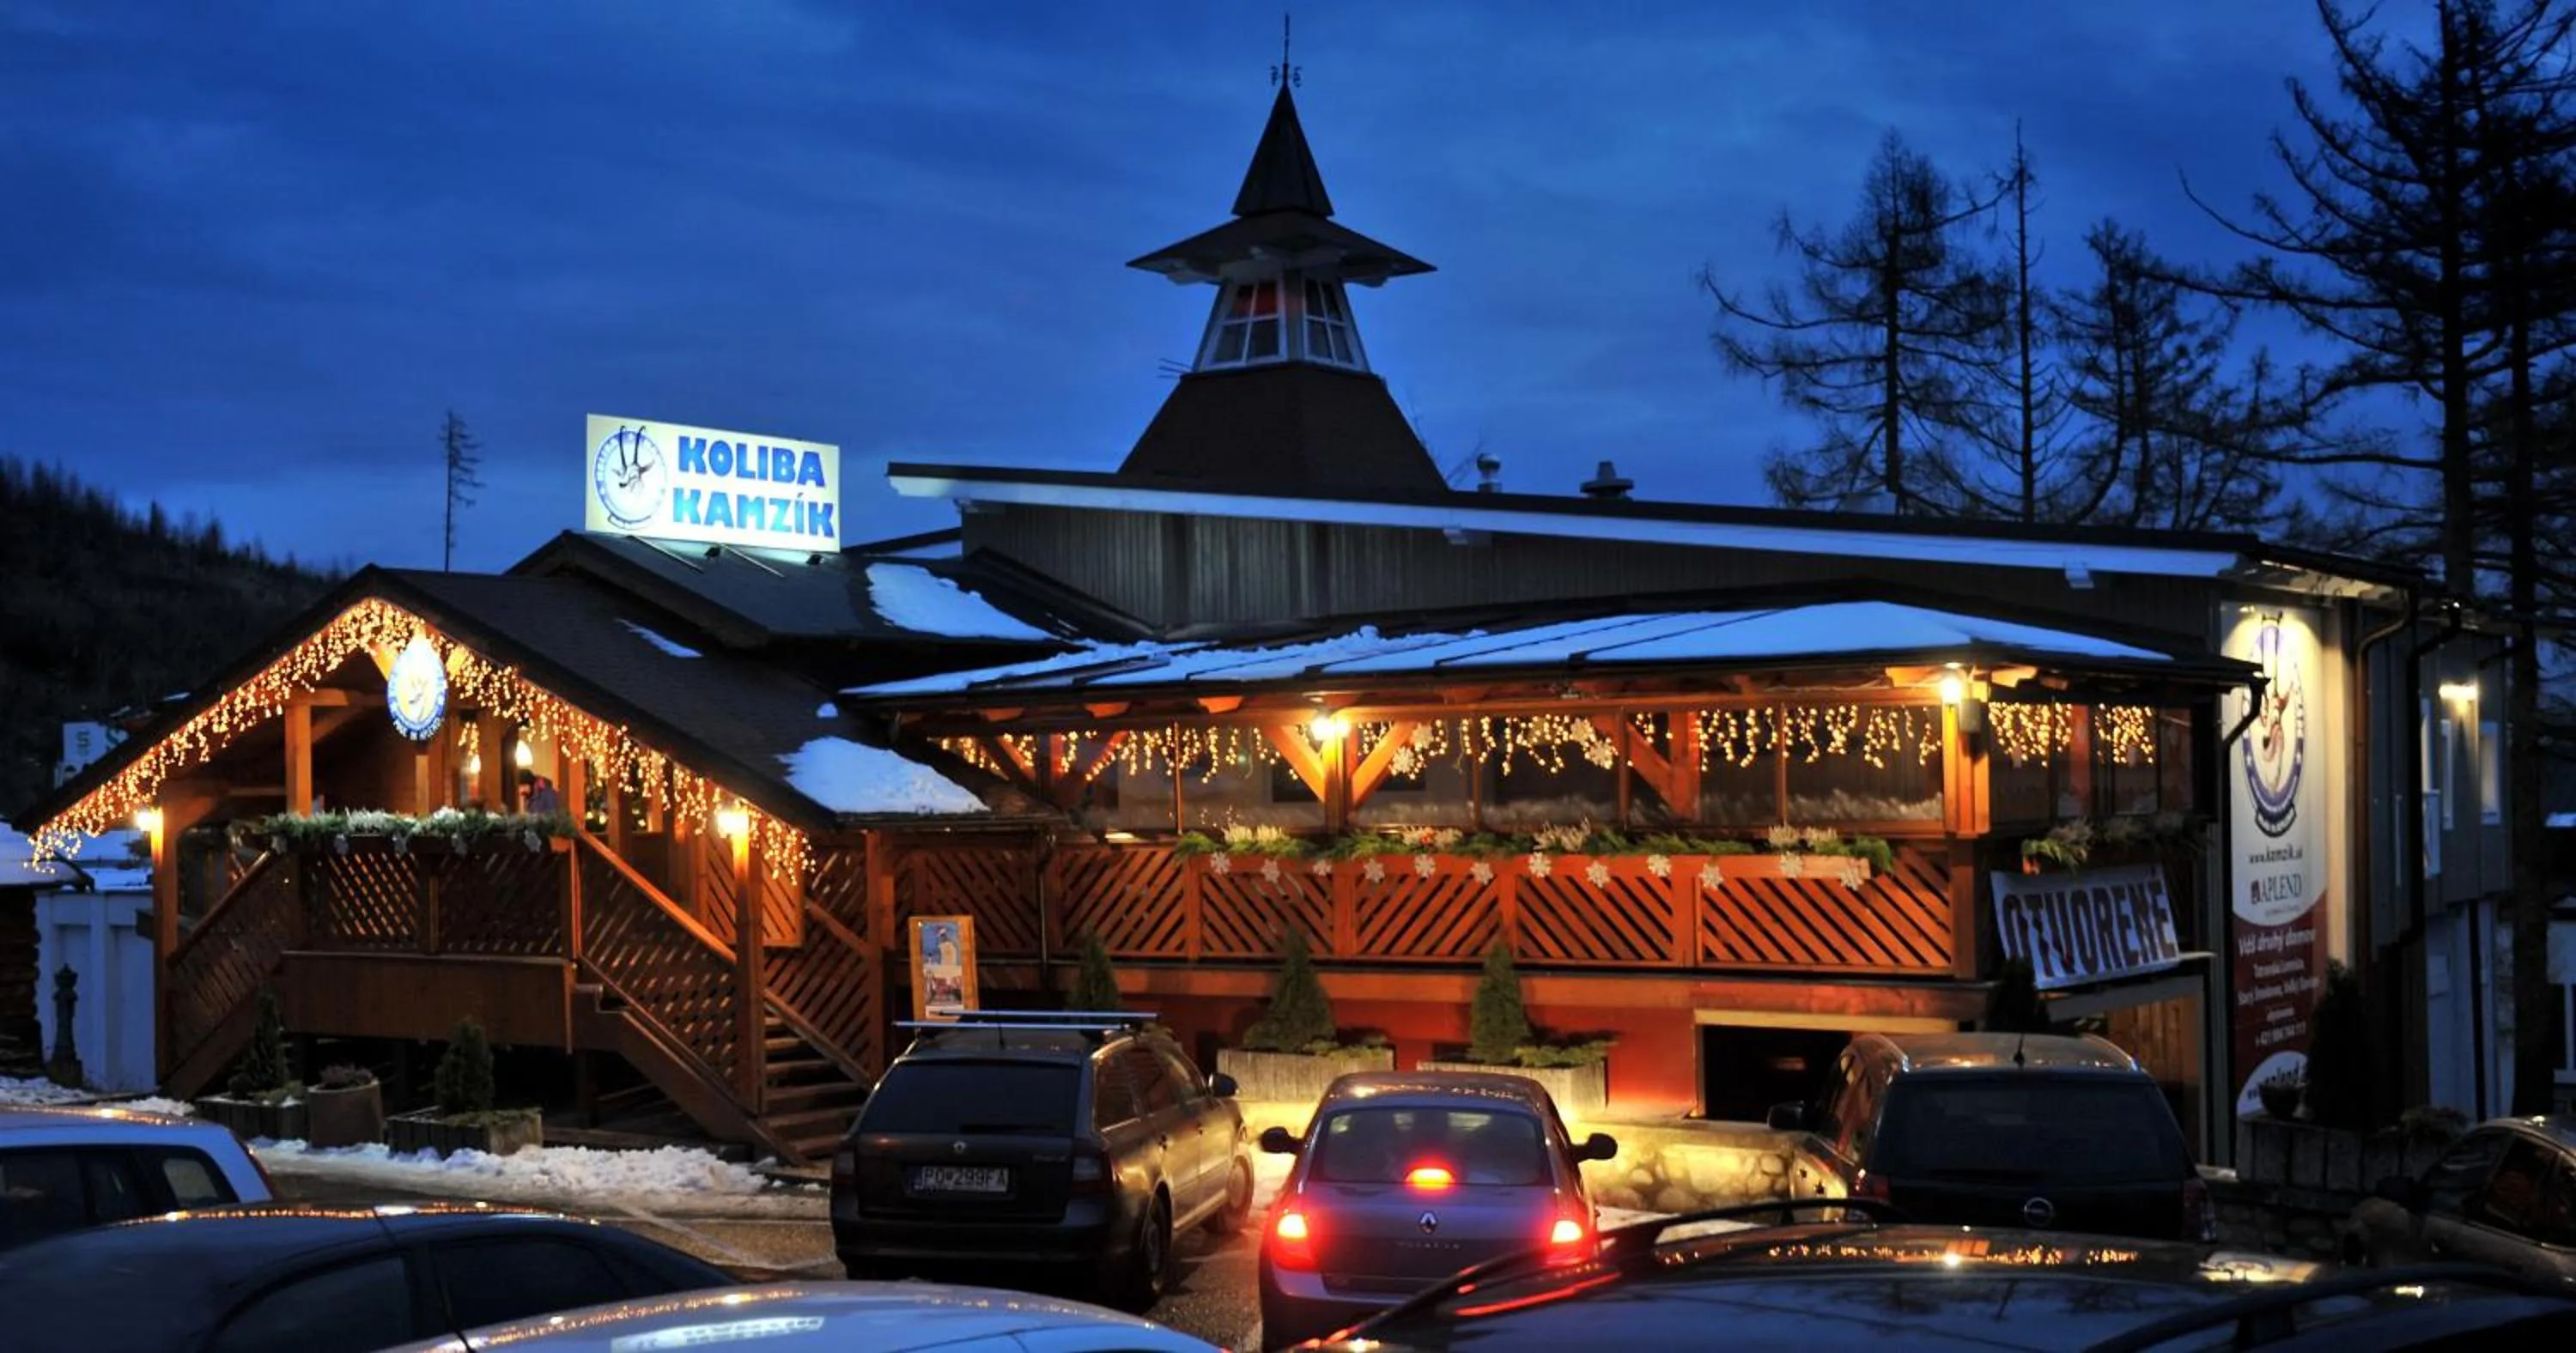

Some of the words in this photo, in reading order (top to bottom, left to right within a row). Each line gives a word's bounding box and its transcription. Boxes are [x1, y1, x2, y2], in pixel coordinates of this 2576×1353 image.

[678, 435, 826, 488] KOLIBA
[672, 487, 835, 538] KAMZÍK
[2261, 873, 2303, 902] APLEND
[2002, 864, 2178, 980] OTVORENÉ
